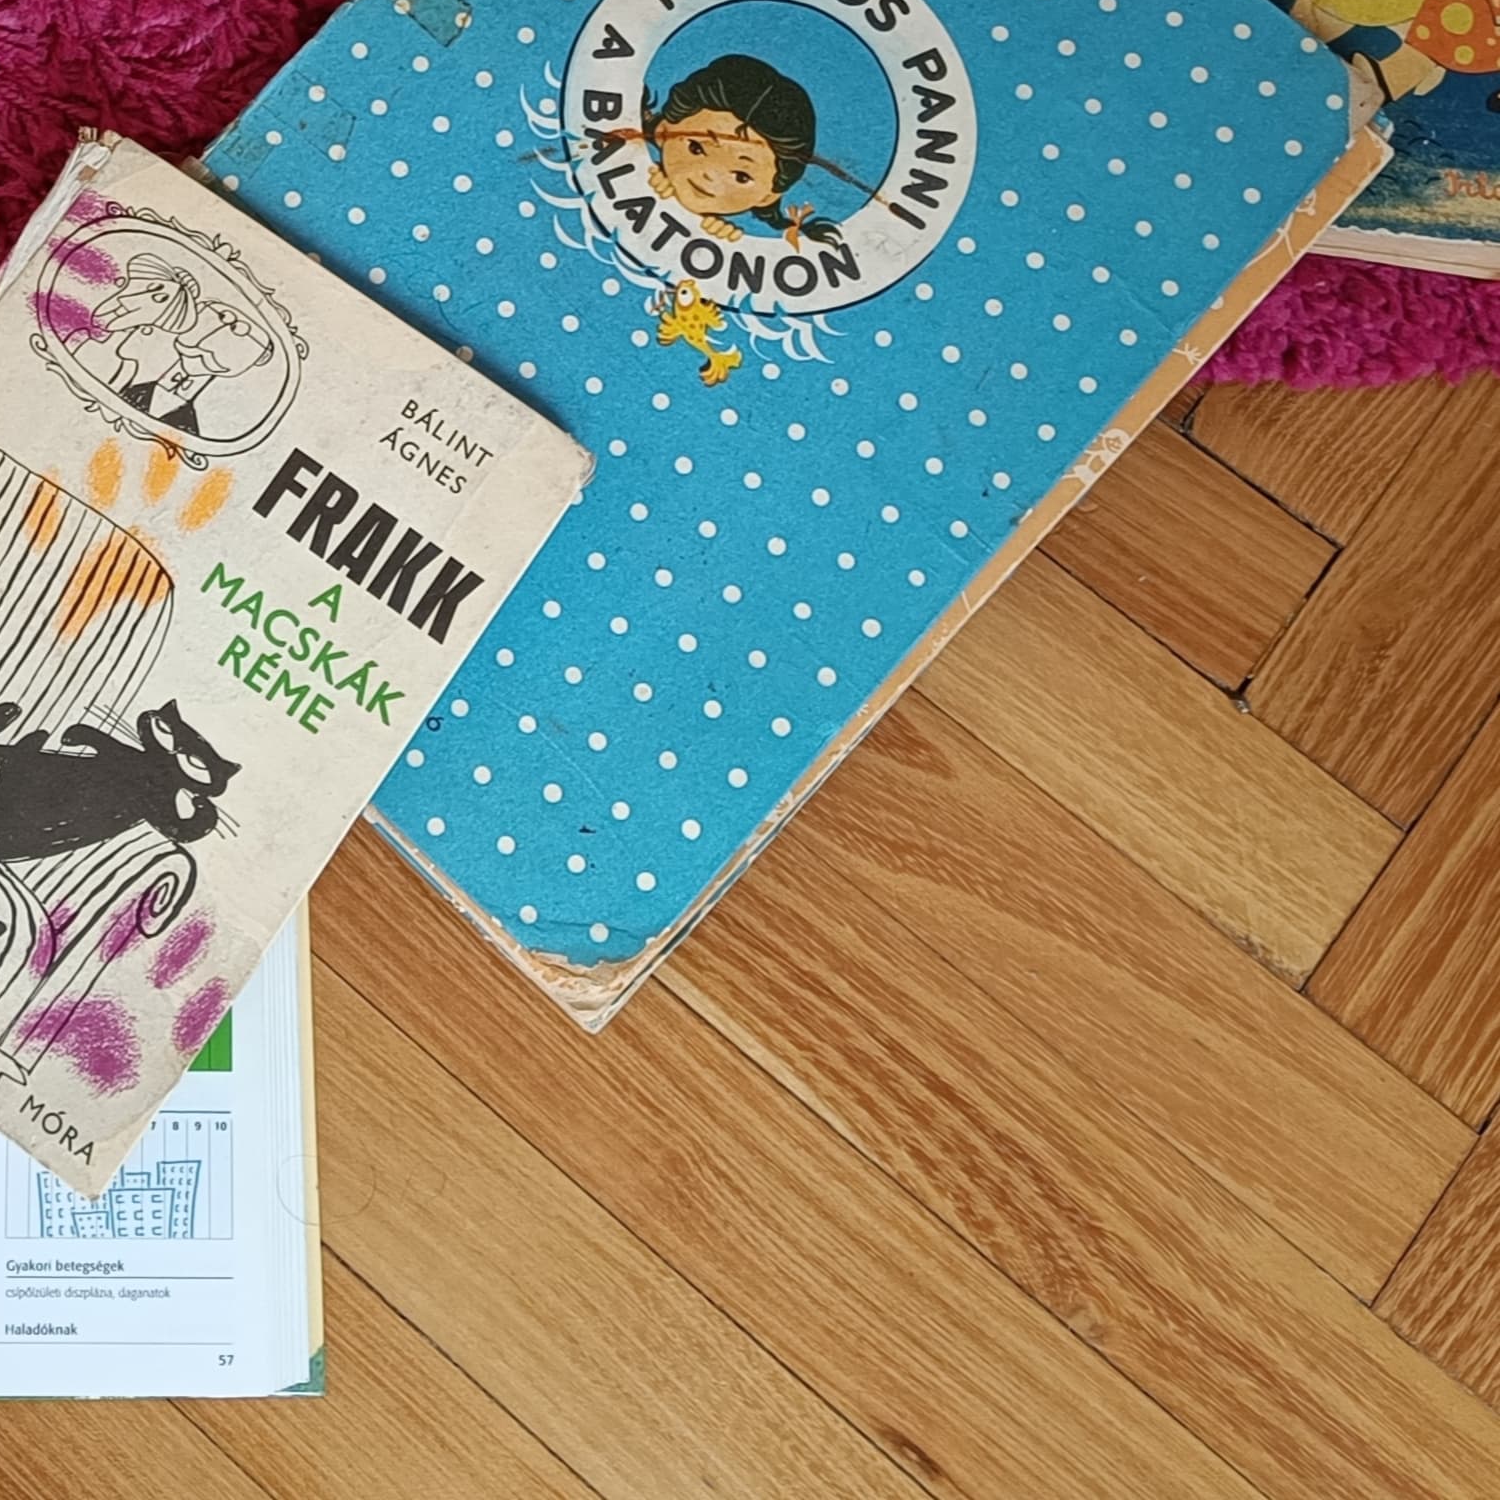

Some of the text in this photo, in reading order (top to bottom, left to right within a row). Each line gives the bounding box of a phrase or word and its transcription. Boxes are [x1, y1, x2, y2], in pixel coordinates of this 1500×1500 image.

[592, 23, 635, 61] A
[887, 46, 959, 231] PANNI
[582, 90, 863, 298] BALATONON
[378, 426, 469, 495] ÁGNES
[400, 398, 495, 469] BÁLINT
[252, 447, 485, 645] FRAKK
[308, 583, 346, 624] A
[200, 561, 406, 726] MACSKÁK
[217, 634, 337, 735] RÉME
[20, 1094, 95, 1166] MÓRA
[172, 1121, 227, 1131] 8 9 10
[6, 1260, 124, 1274] Gyakori betegségek
[118, 1287, 170, 1301] daganatok
[5, 1323, 78, 1335] Haladóknak
[218, 1354, 234, 1366] 57
